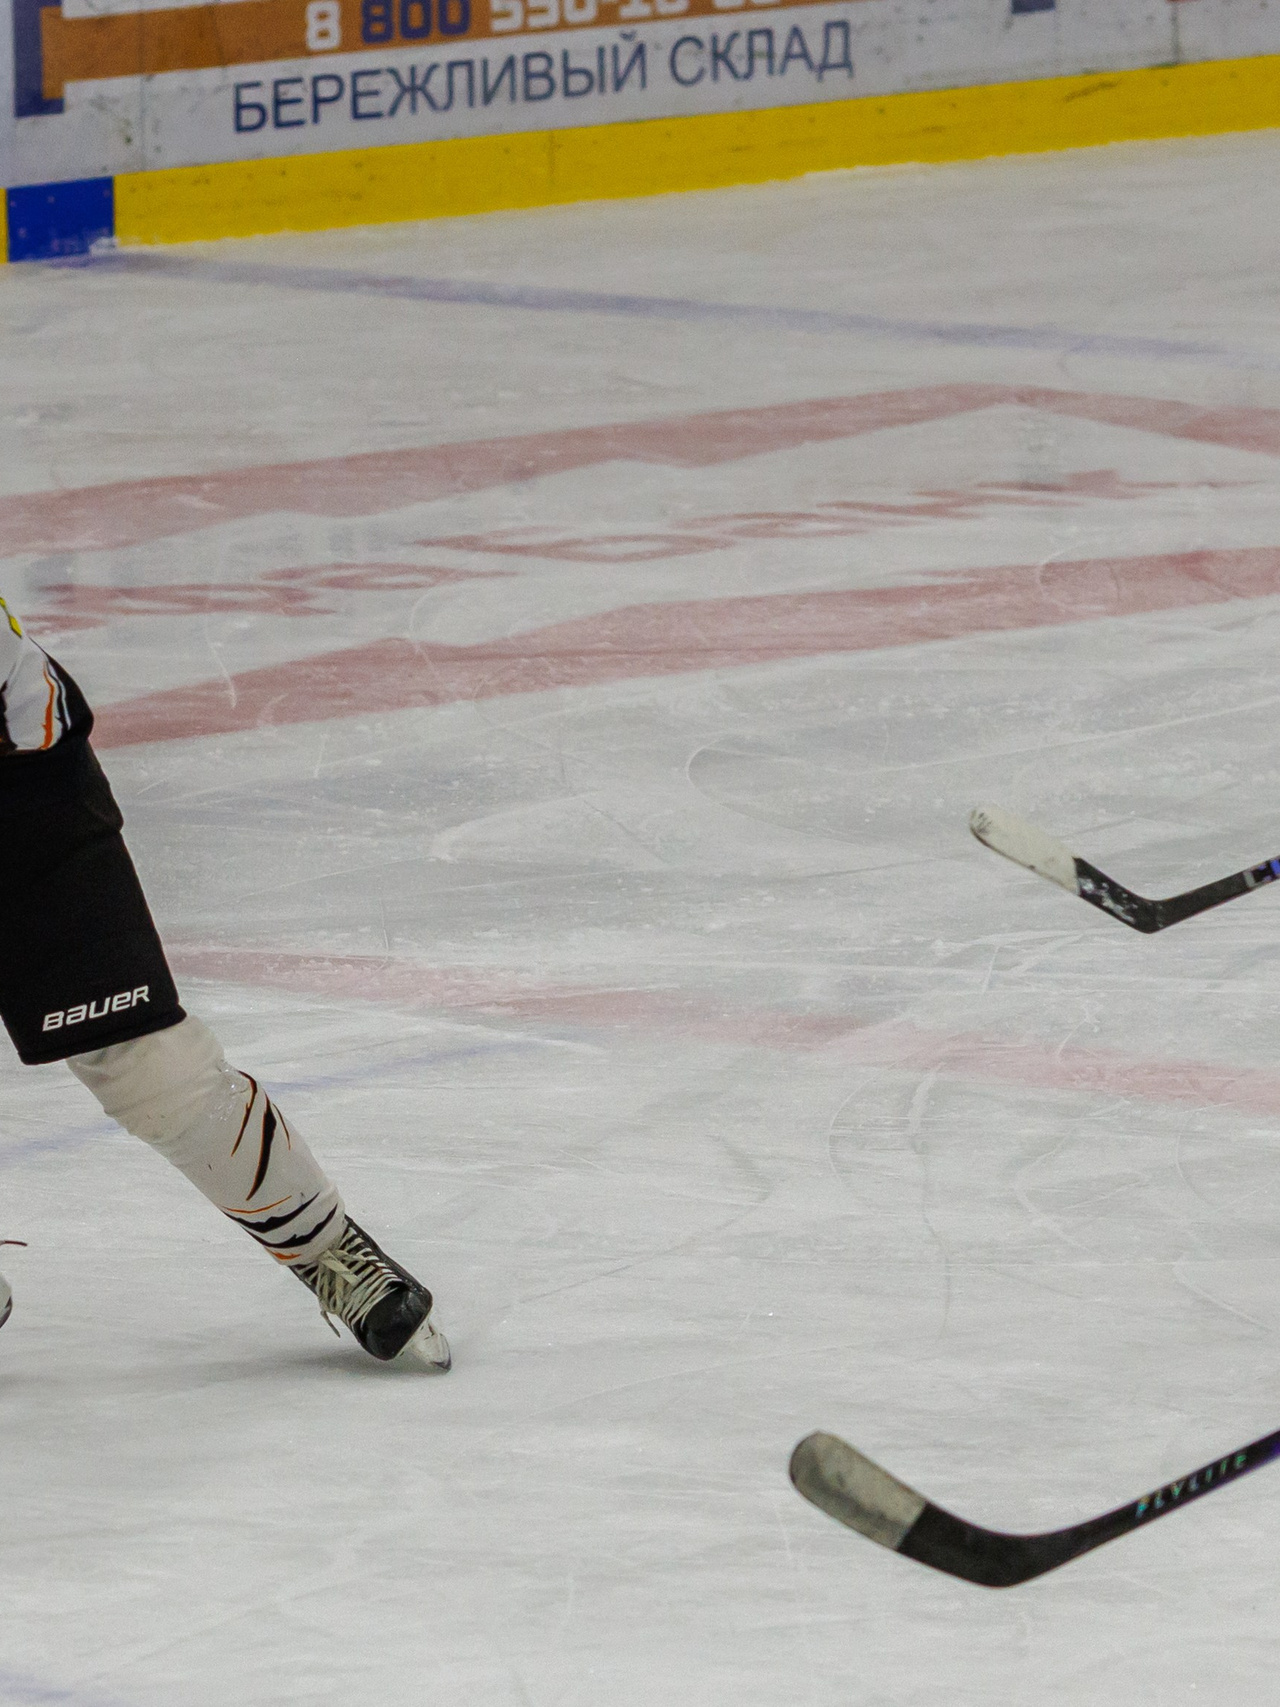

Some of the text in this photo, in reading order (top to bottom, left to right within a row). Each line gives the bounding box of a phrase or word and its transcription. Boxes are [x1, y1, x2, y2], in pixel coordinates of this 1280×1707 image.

[305, 0, 341, 50] 8
[361, 0, 471, 45] 800
[233, 19, 855, 133] БЕРЕЖЛИВЫЙ СКЛАД
[41, 984, 151, 1033] BAUER
